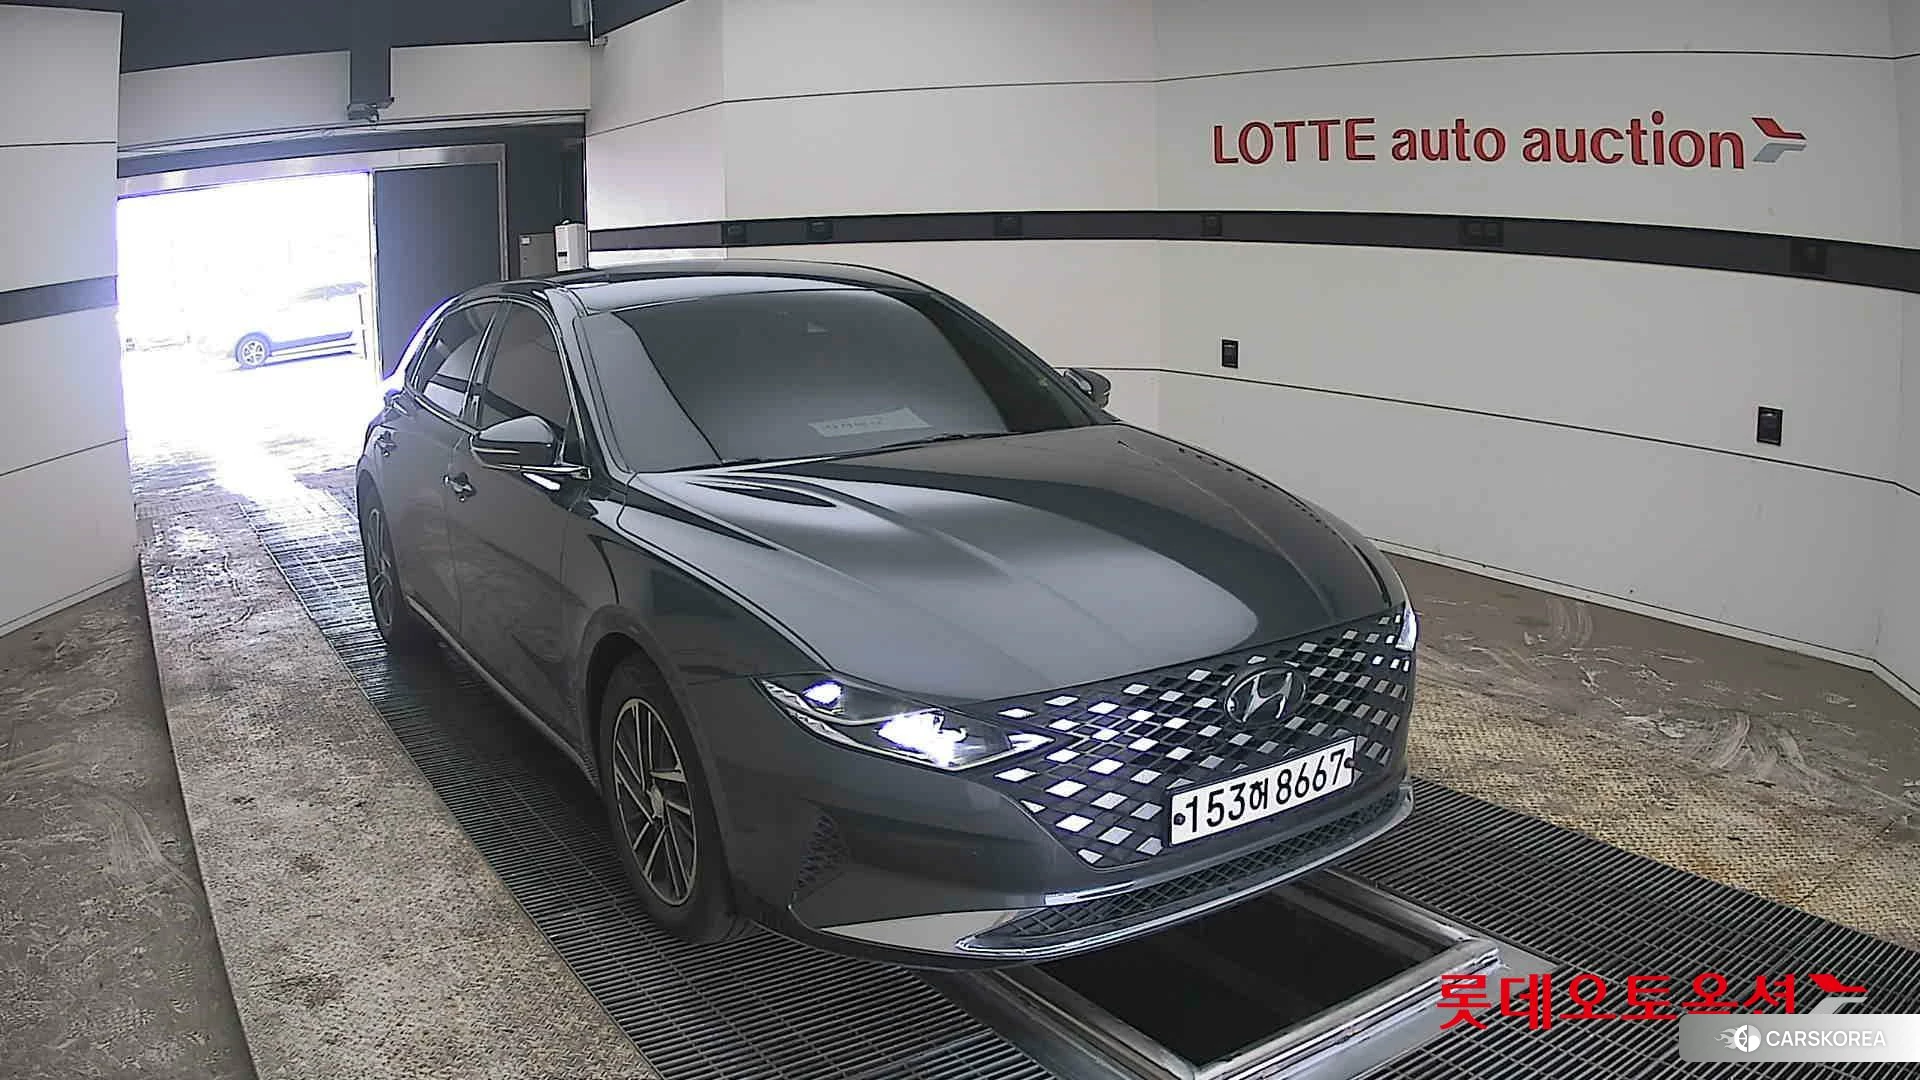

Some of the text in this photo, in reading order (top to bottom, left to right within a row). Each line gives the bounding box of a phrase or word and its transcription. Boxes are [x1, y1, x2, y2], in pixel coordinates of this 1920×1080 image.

[1213, 110, 1745, 170] LOTTE auto auction
[1185, 748, 1346, 833] 153허 8667
